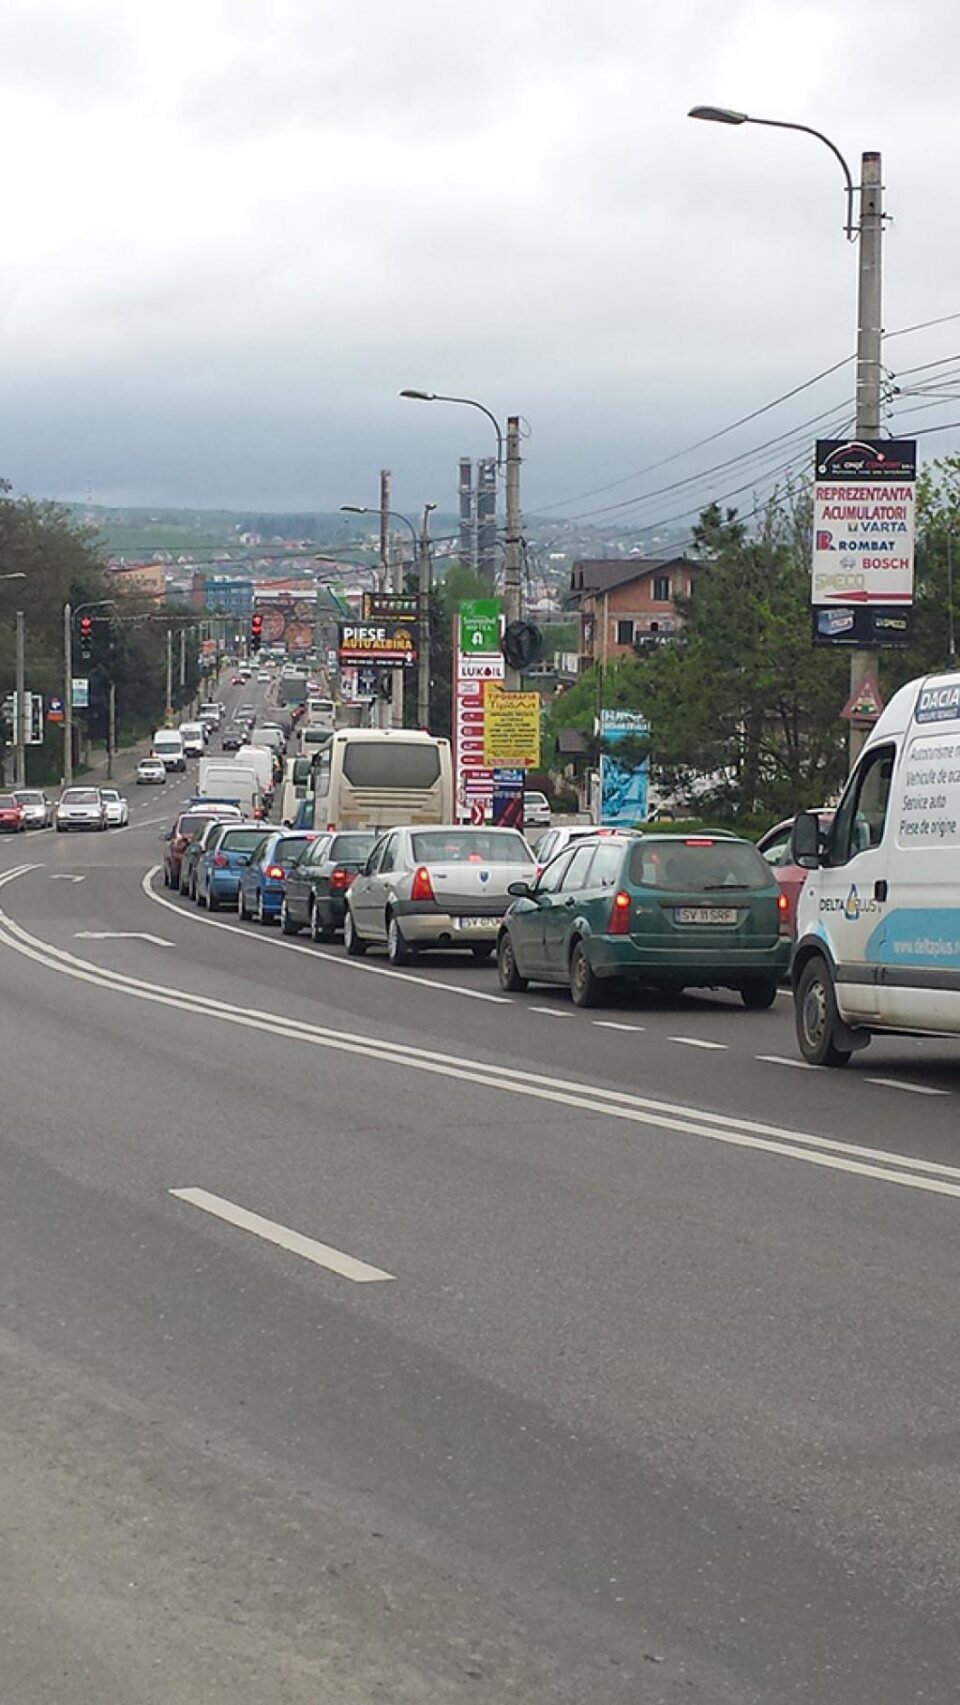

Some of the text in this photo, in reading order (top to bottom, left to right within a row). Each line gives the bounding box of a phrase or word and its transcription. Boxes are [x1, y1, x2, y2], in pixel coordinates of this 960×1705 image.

[816, 487, 913, 501] REPREZENTANTA
[821, 506, 907, 520] ACUMULATORI
[861, 521, 908, 532] VARTA
[838, 541, 896, 551] ROMBAT
[862, 558, 909, 569] BOSCH
[343, 628, 387, 642] PIESE
[920, 689, 959, 709] DACIA
[902, 794, 947, 811] Service auto
[900, 818, 919, 835] Piese
[930, 816, 957, 838] origine
[820, 898, 844, 911] DELTA
[682, 910, 697, 920] SV
